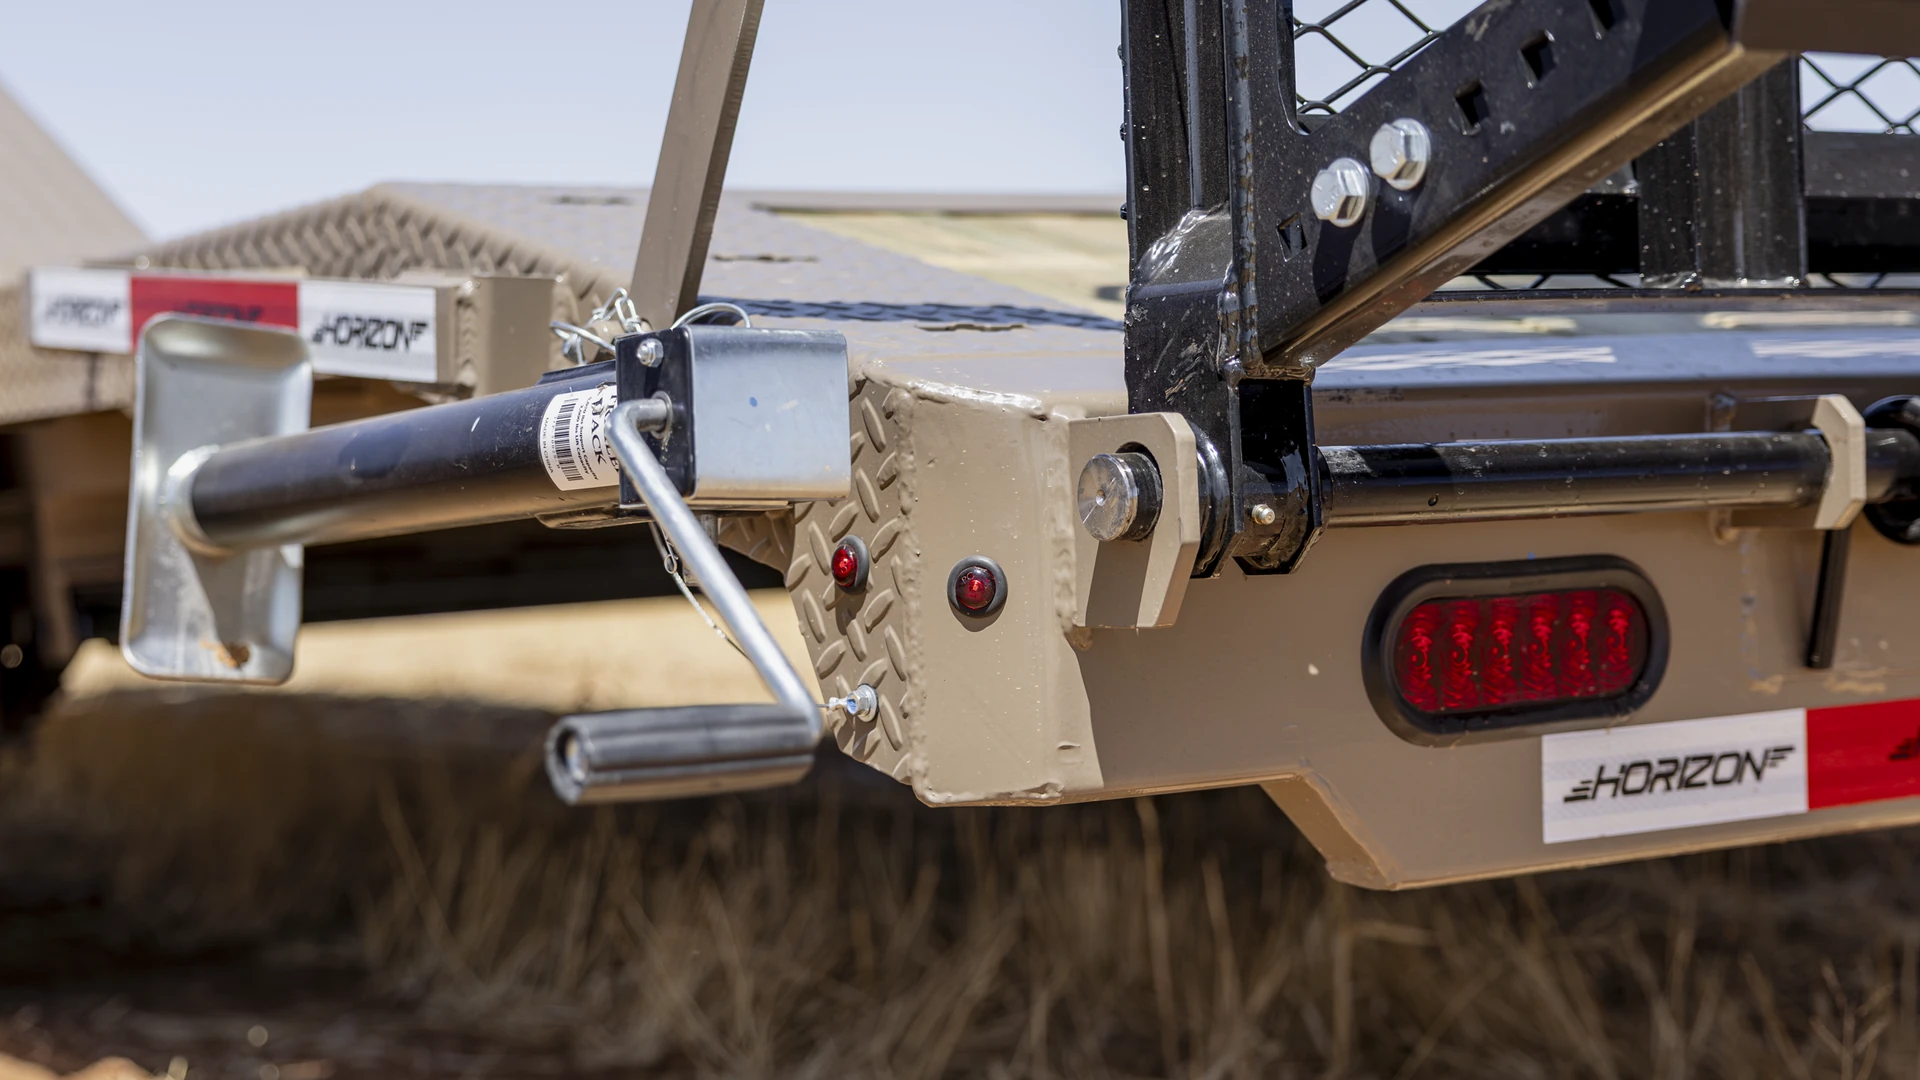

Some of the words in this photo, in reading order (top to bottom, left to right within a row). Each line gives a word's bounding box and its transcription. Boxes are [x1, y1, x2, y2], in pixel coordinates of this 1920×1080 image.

[312, 314, 429, 350] HORIZON
[544, 451, 554, 474] CHINA
[576, 447, 589, 474] Capacity
[583, 454, 598, 480] Capacity
[1563, 746, 1795, 802] HORIZON
